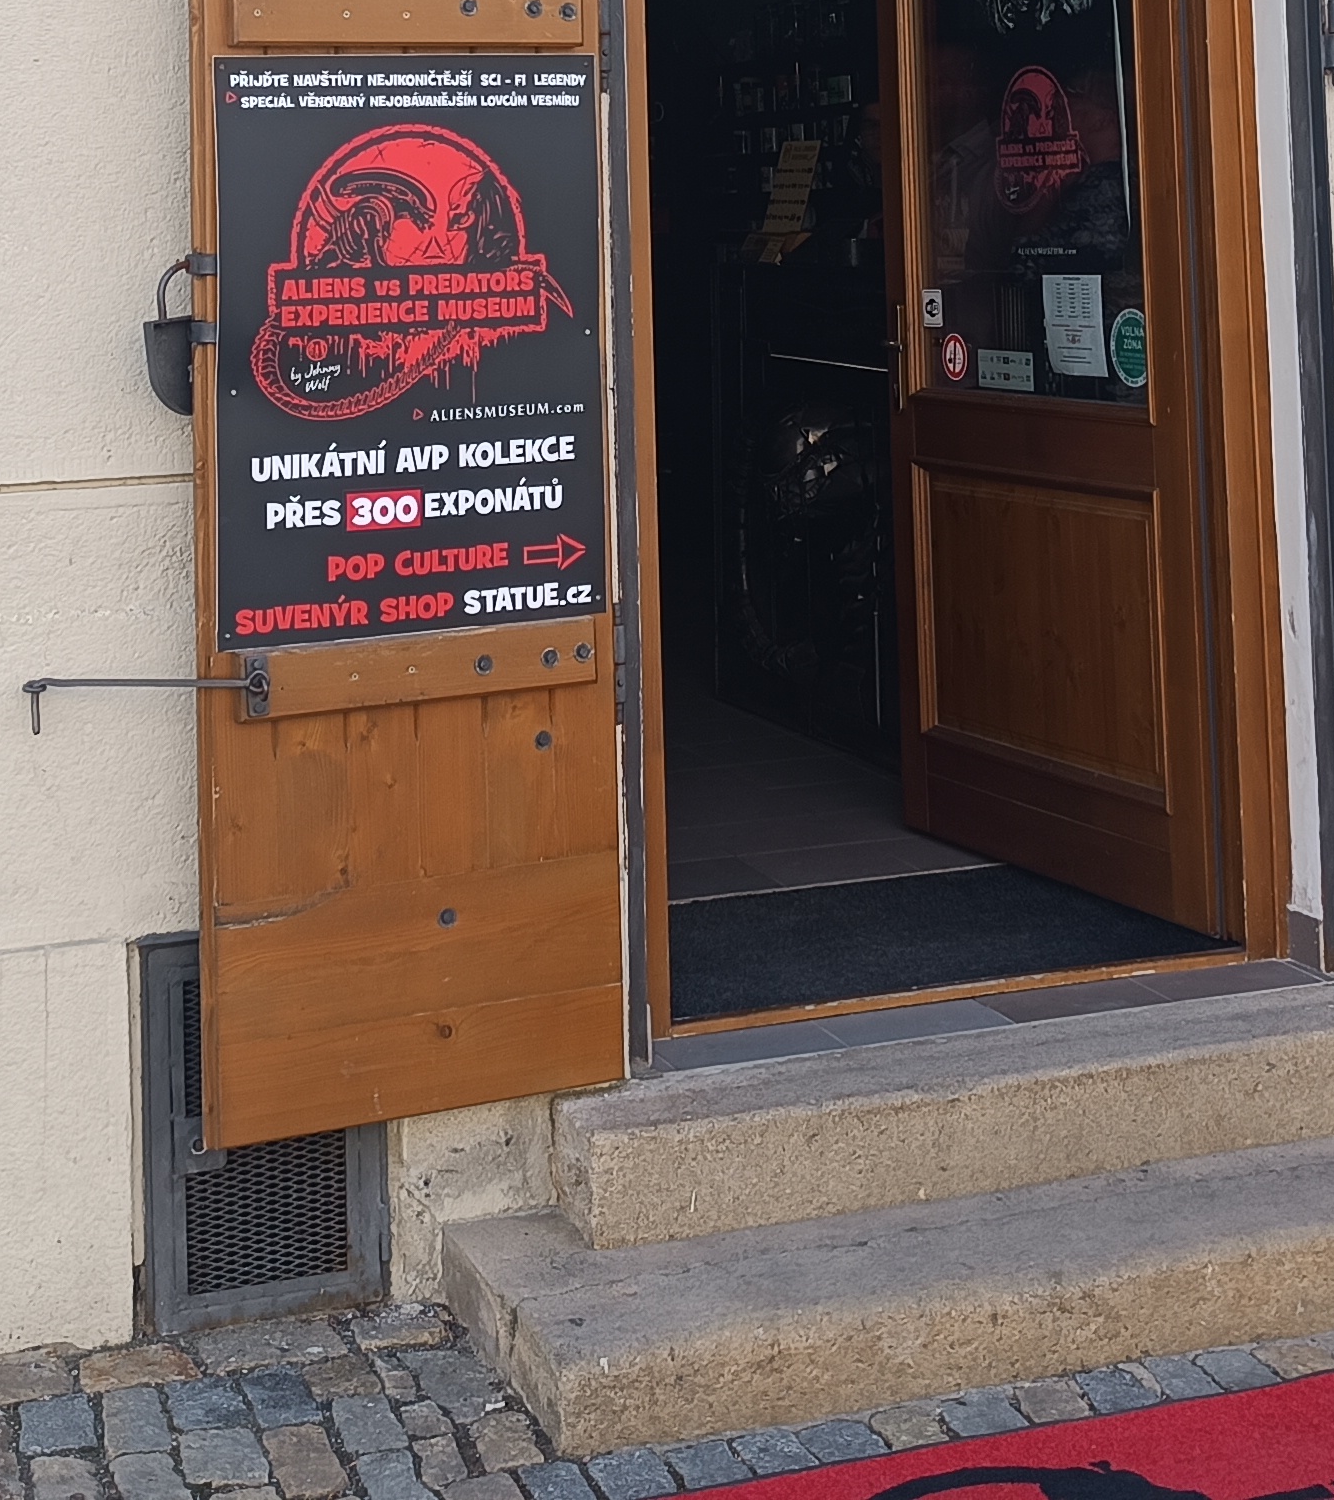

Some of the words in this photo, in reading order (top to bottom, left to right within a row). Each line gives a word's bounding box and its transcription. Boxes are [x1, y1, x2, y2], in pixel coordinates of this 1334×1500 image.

[293, 70, 363, 87] NAVŠTÍVIT
[367, 70, 472, 88] NEJIKONIČTĚJŠÍ
[480, 74, 501, 86] SCI
[515, 74, 526, 87] FI
[534, 74, 586, 87] LEGENDY
[240, 92, 295, 108] SPECIÁL
[299, 91, 366, 108] VĚNOVANÝ
[369, 91, 478, 108] NEJOBÁVANĚJŠÍM
[481, 90, 528, 107] LOVCŮM
[531, 90, 580, 107] VESMÍRU
[281, 277, 365, 300] ALIENS
[408, 271, 534, 296] PREDATORS
[281, 301, 429, 328] EXPERIENCE
[437, 296, 535, 321] MUSEUM
[430, 402, 585, 422] ALIENSMUSEUM.com
[251, 440, 387, 482] UNIKÁTNÍ
[395, 445, 449, 473] AVP
[459, 436, 576, 468] KOLEKCE
[266, 495, 341, 529] PŘES
[351, 495, 418, 526] 300
[424, 477, 563, 517] EXPONÁTŮ
[327, 552, 385, 582] POP
[394, 542, 509, 576] CULTURE
[235, 594, 369, 635] SUVENÝR
[380, 592, 454, 624] SHOP
